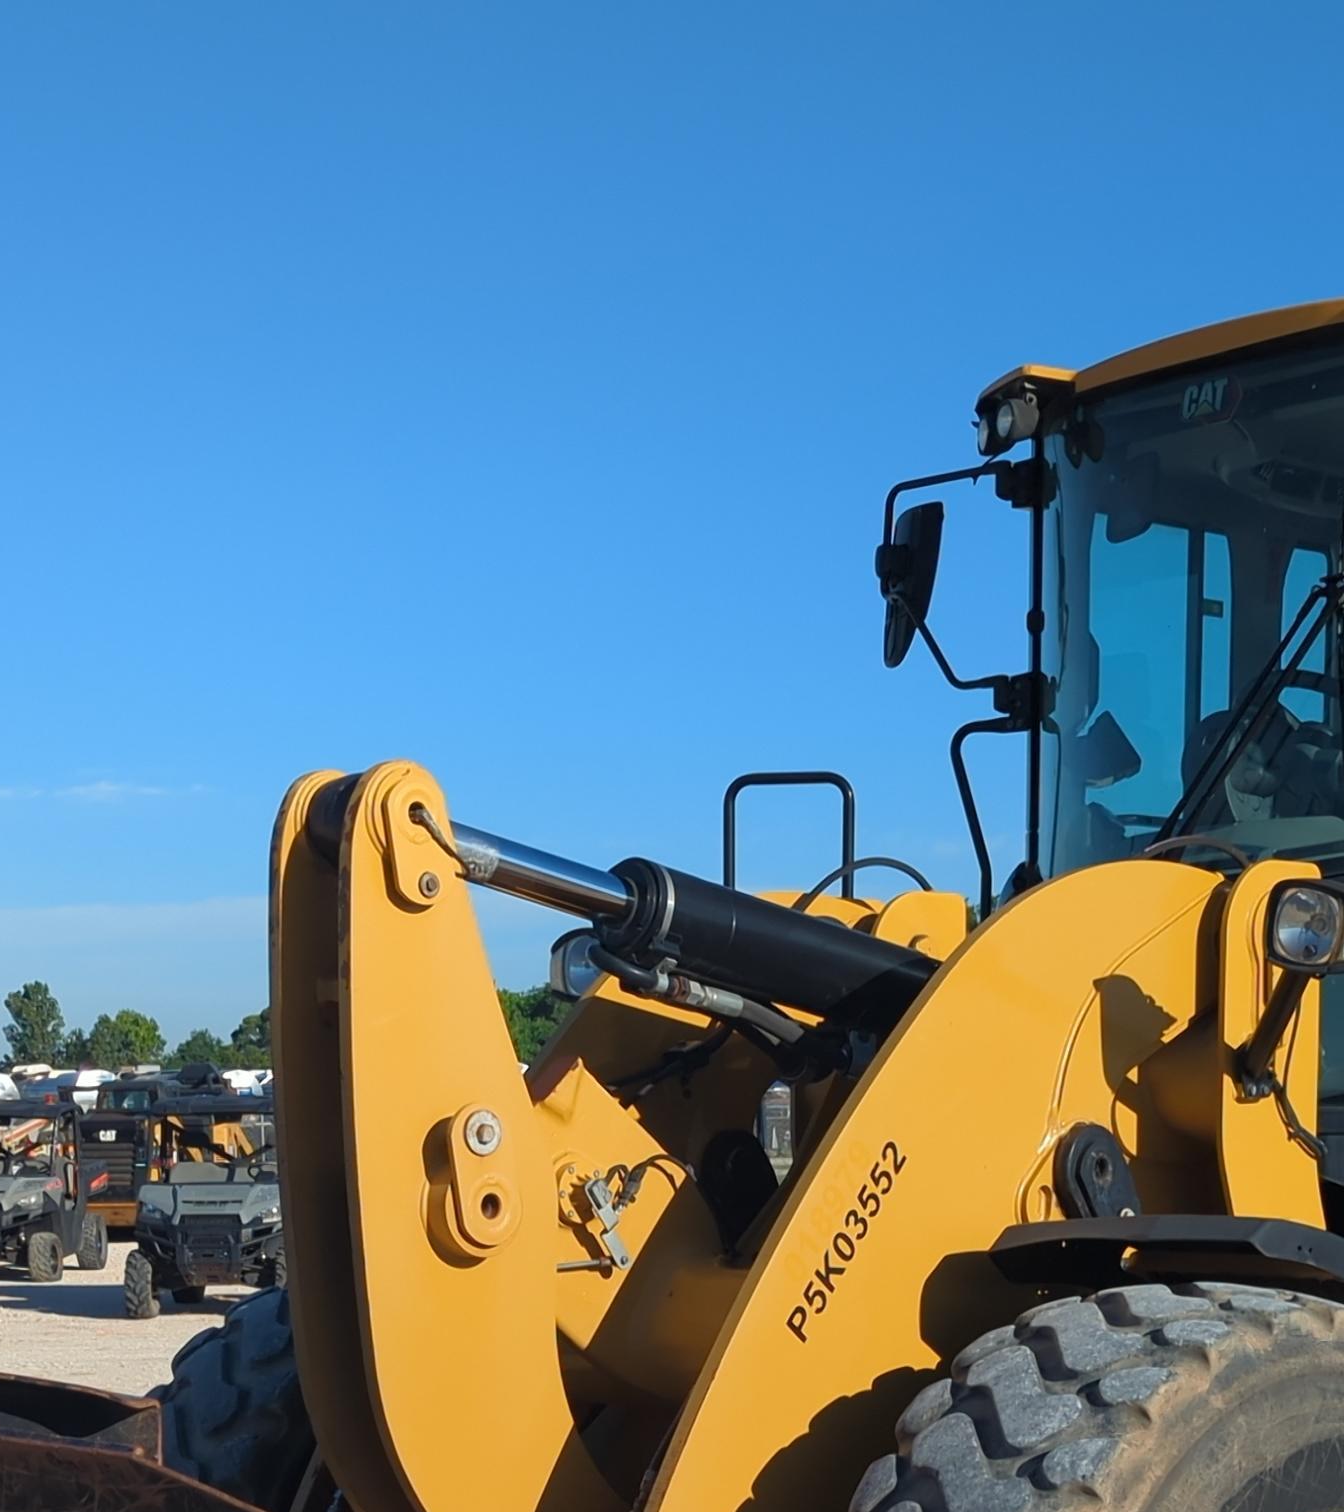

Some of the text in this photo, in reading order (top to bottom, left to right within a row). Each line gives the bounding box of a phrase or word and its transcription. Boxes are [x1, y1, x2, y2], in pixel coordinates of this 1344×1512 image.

[1182, 378, 1228, 419] CAT
[99, 1129, 117, 1141] CAT
[786, 1141, 907, 1344] P5K03552
